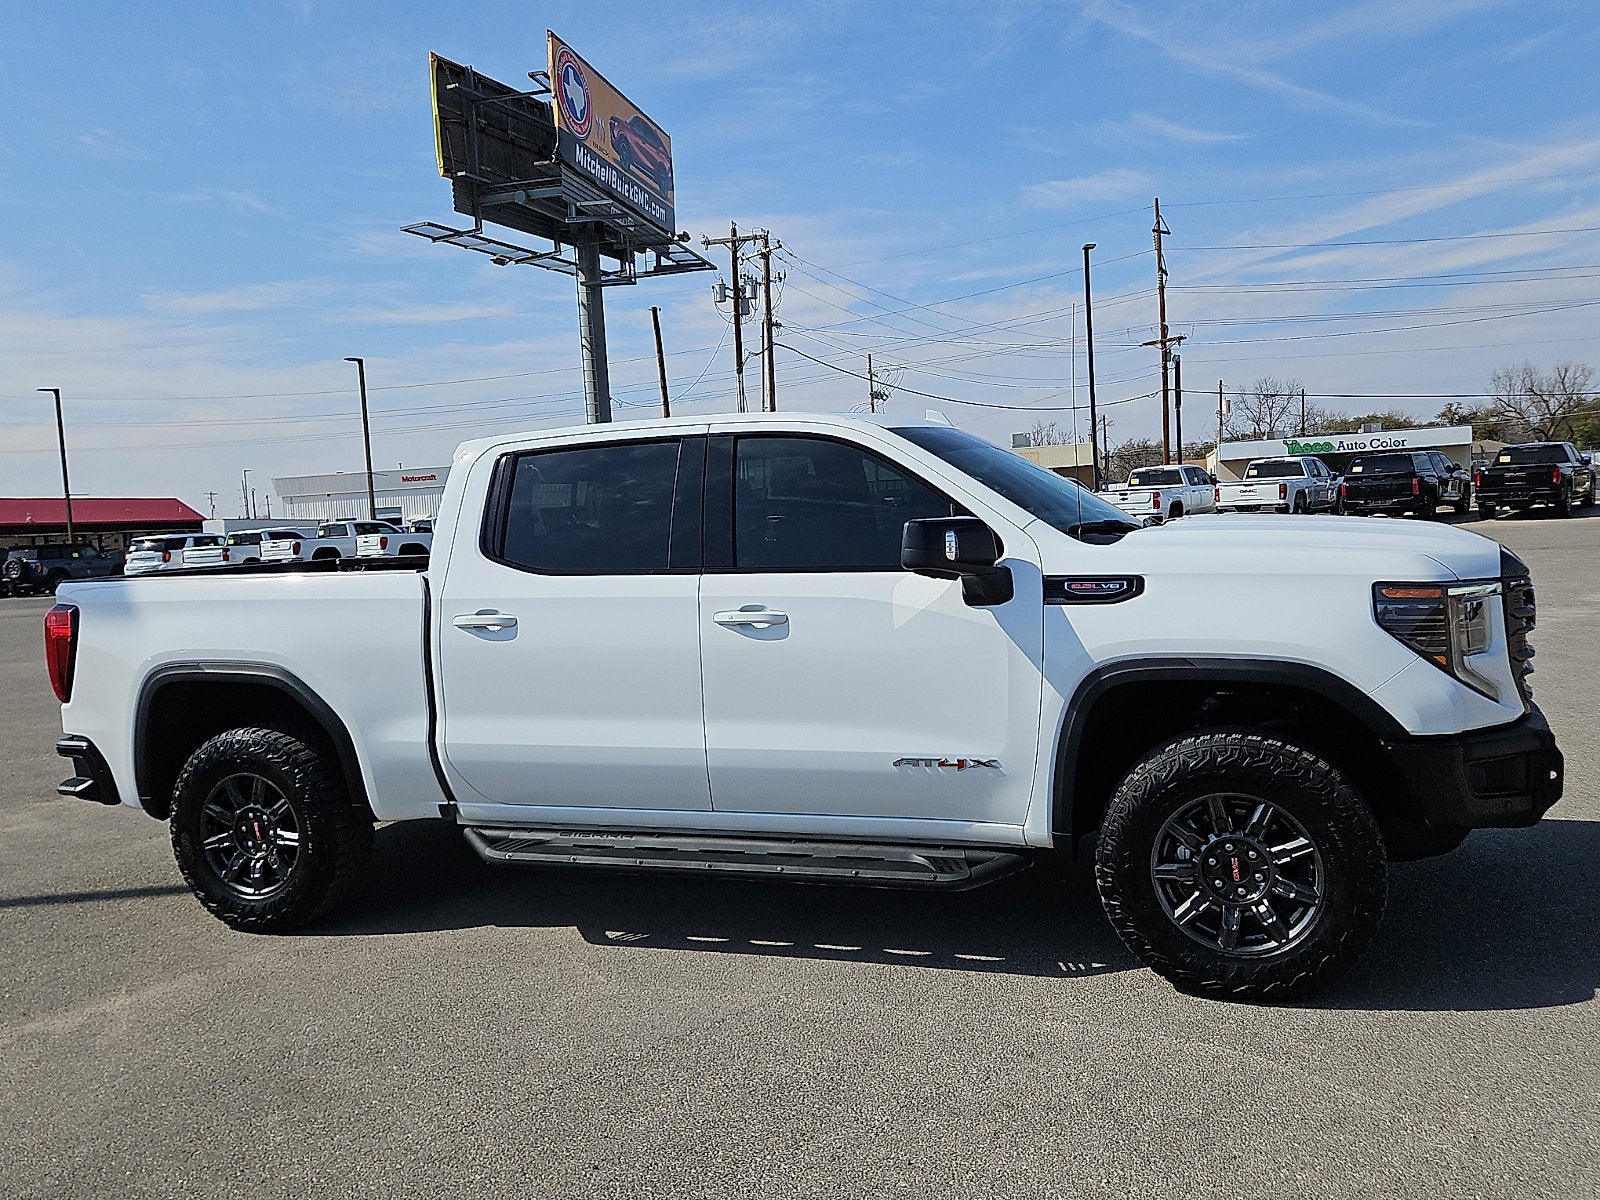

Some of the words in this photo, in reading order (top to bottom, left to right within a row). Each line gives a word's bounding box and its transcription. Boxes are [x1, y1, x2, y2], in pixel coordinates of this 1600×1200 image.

[575, 144, 667, 222] MitchellBuickGMC.com
[1336, 440, 1367, 451] Auto
[1369, 438, 1407, 449] Color
[401, 474, 437, 482] Motorcraft
[892, 757, 1001, 772] AT4X
